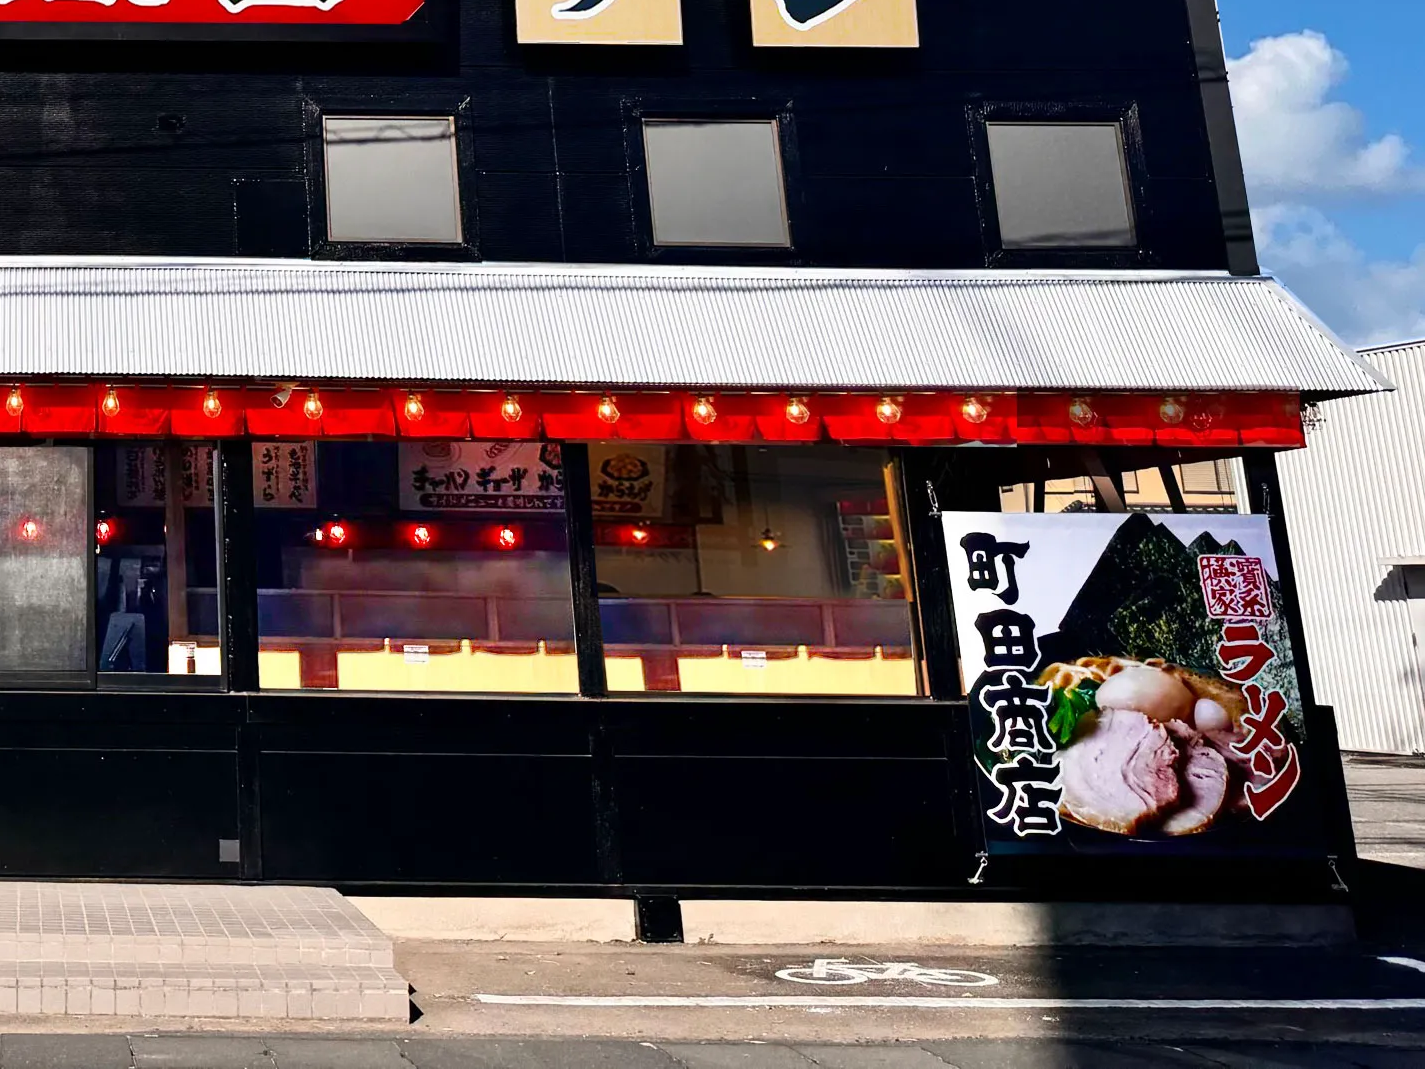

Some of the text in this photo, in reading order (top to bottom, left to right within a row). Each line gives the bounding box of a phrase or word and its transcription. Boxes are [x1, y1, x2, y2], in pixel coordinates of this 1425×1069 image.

[959, 531, 1063, 836] 町田商店
[1216, 622, 1301, 821] ラーメン
